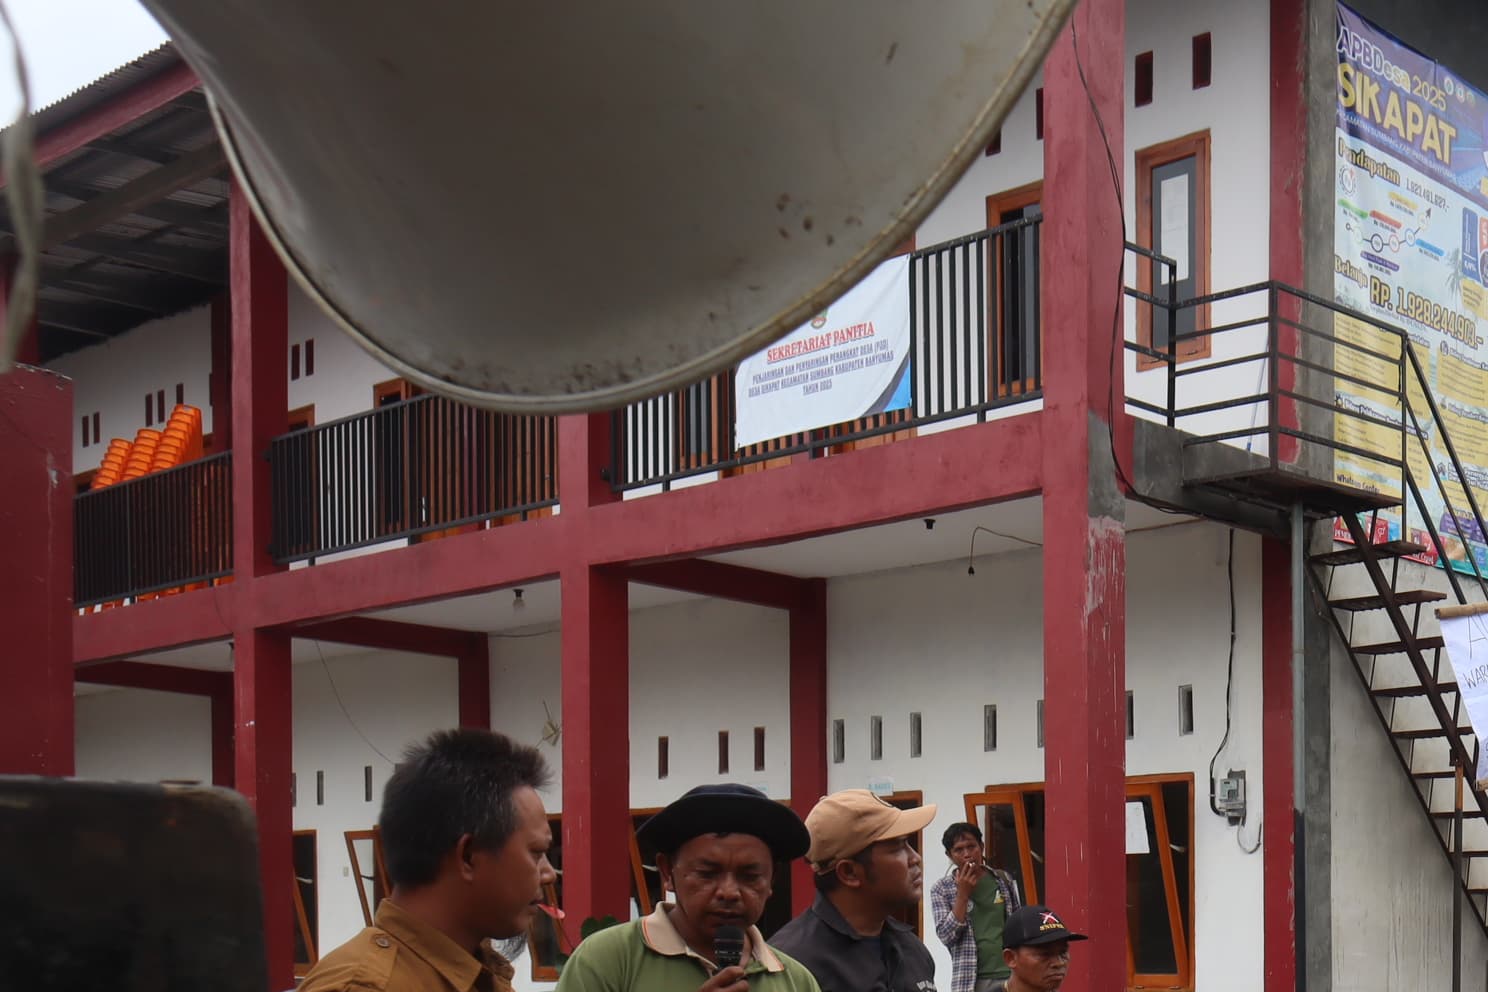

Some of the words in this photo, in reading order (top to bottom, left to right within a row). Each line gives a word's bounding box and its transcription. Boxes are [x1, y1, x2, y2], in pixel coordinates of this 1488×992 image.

[1413, 75, 1446, 111] 2025
[1337, 62, 1457, 165] SIKAPAT
[1370, 275, 1393, 310] RP.
[767, 332, 832, 364] SEKRETARIAT
[833, 321, 874, 345] PANITIA
